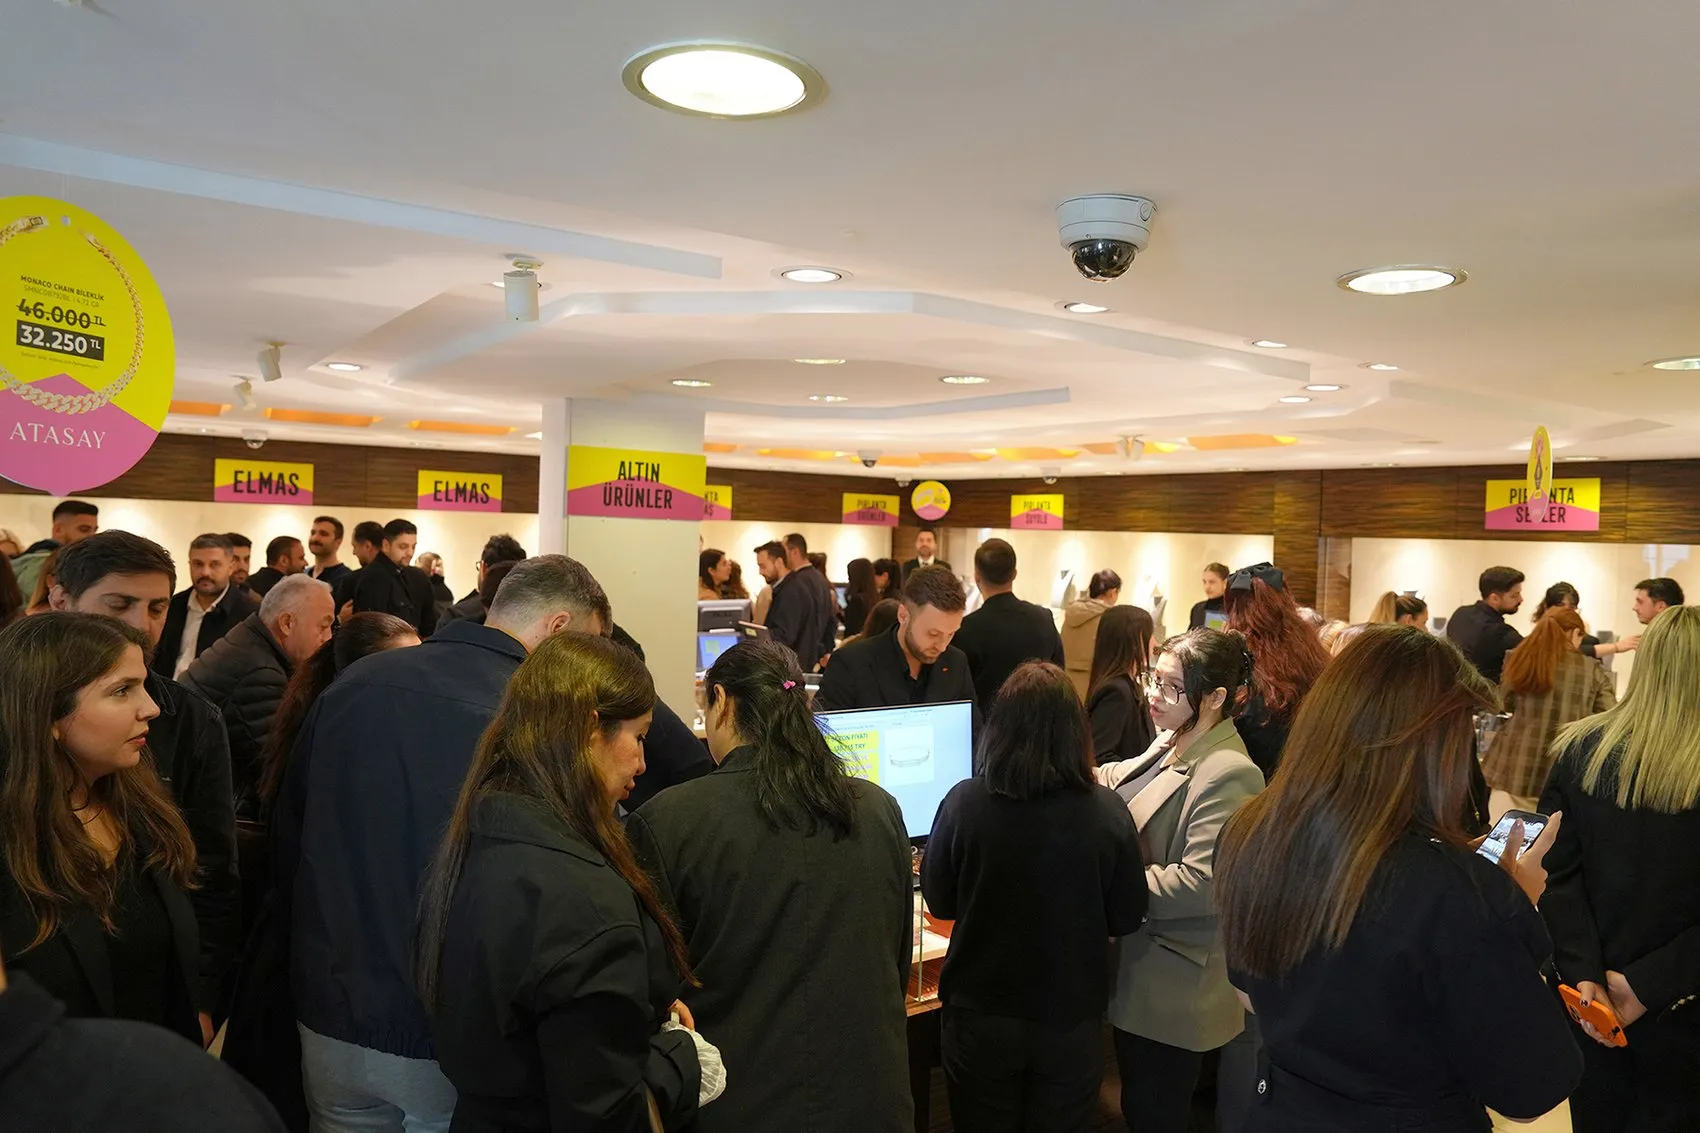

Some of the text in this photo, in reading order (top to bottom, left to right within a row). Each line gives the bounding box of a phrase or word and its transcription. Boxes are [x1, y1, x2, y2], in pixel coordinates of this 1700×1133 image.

[20, 275, 105, 301] MONACO CHAIN BİLEKLİK
[17, 298, 104, 329] 46.000 TL
[20, 324, 101, 354] 32.250 TL
[9, 421, 107, 449] ATASAY
[233, 470, 300, 496] ELMAS
[617, 461, 661, 483] ALTIN
[433, 480, 491, 505] ELMAS
[603, 482, 673, 509] ÜRÜNLER
[1509, 487, 1575, 504] PINTA
[1515, 506, 1566, 523] SELER
